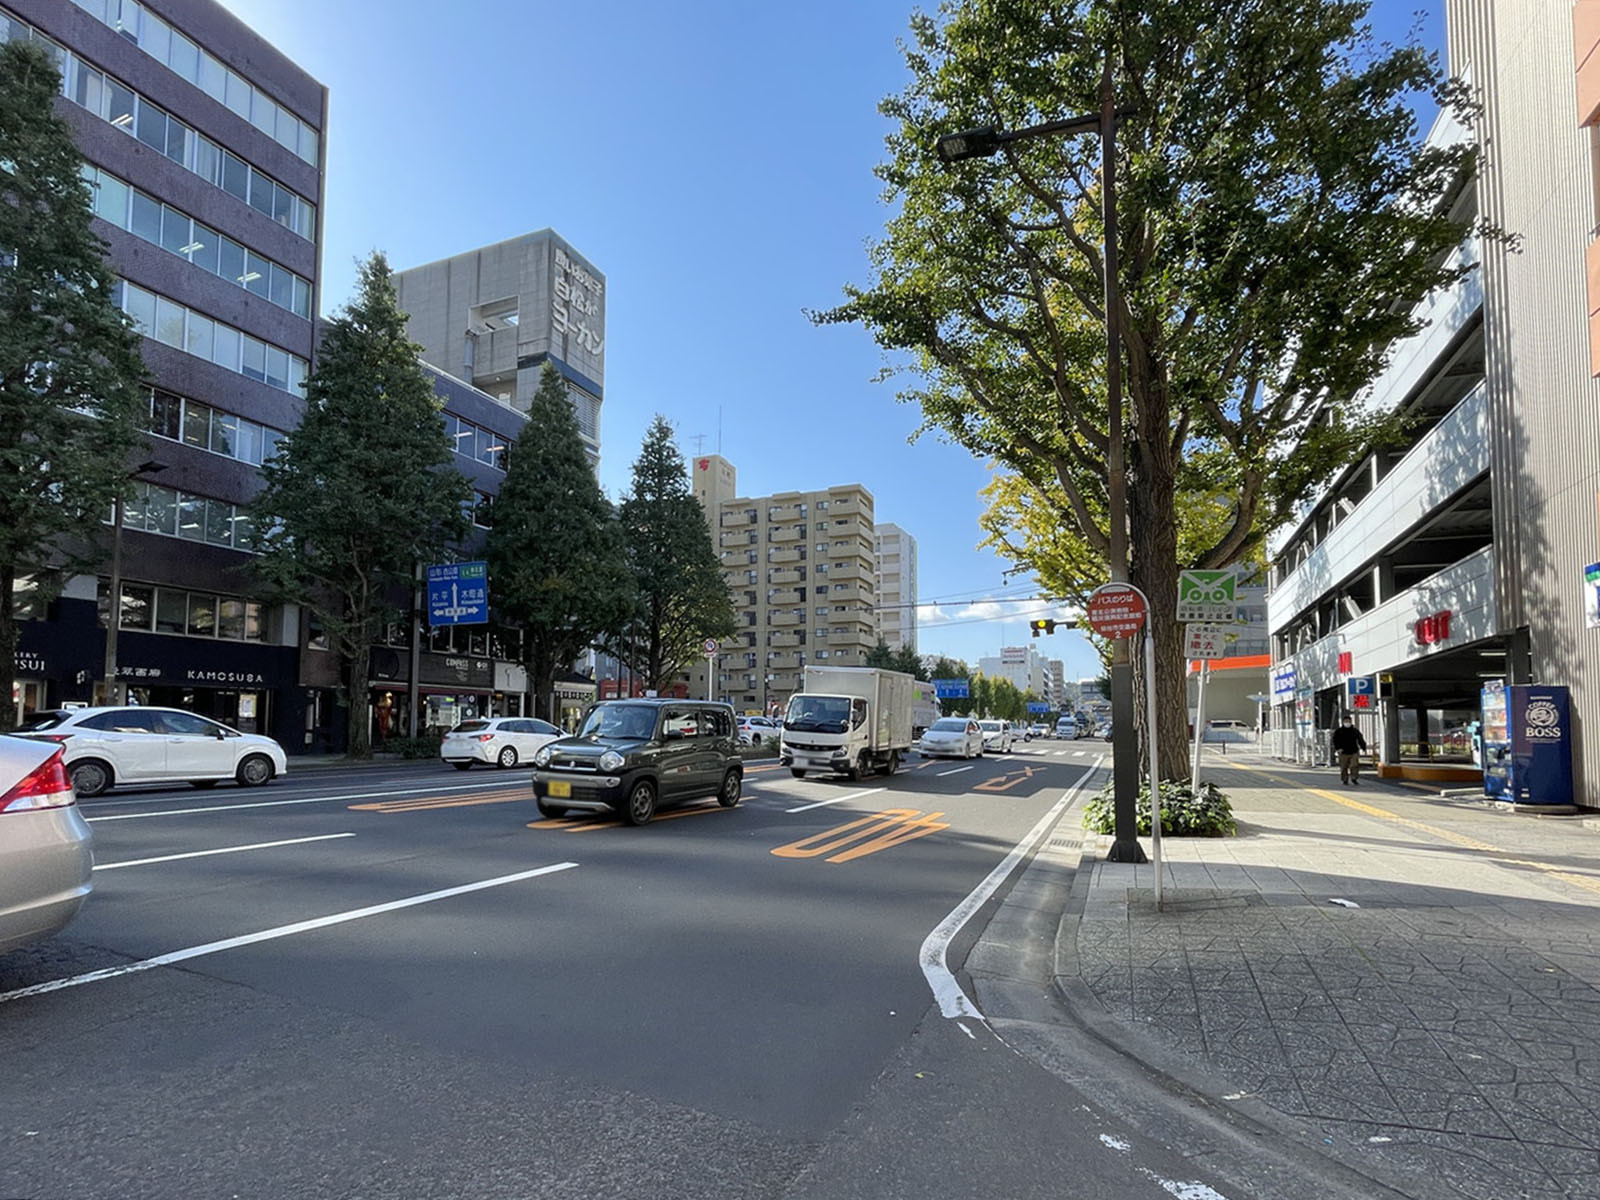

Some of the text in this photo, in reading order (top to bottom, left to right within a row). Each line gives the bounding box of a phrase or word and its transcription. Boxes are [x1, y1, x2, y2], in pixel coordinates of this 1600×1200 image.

[554, 276, 599, 316] 白松が
[552, 301, 604, 356] ヨーカン
[1097, 594, 1134, 605] バスのりば
[1114, 631, 1122, 639] 2
[1356, 679, 1369, 694] P
[1526, 727, 1561, 738] BOSS
